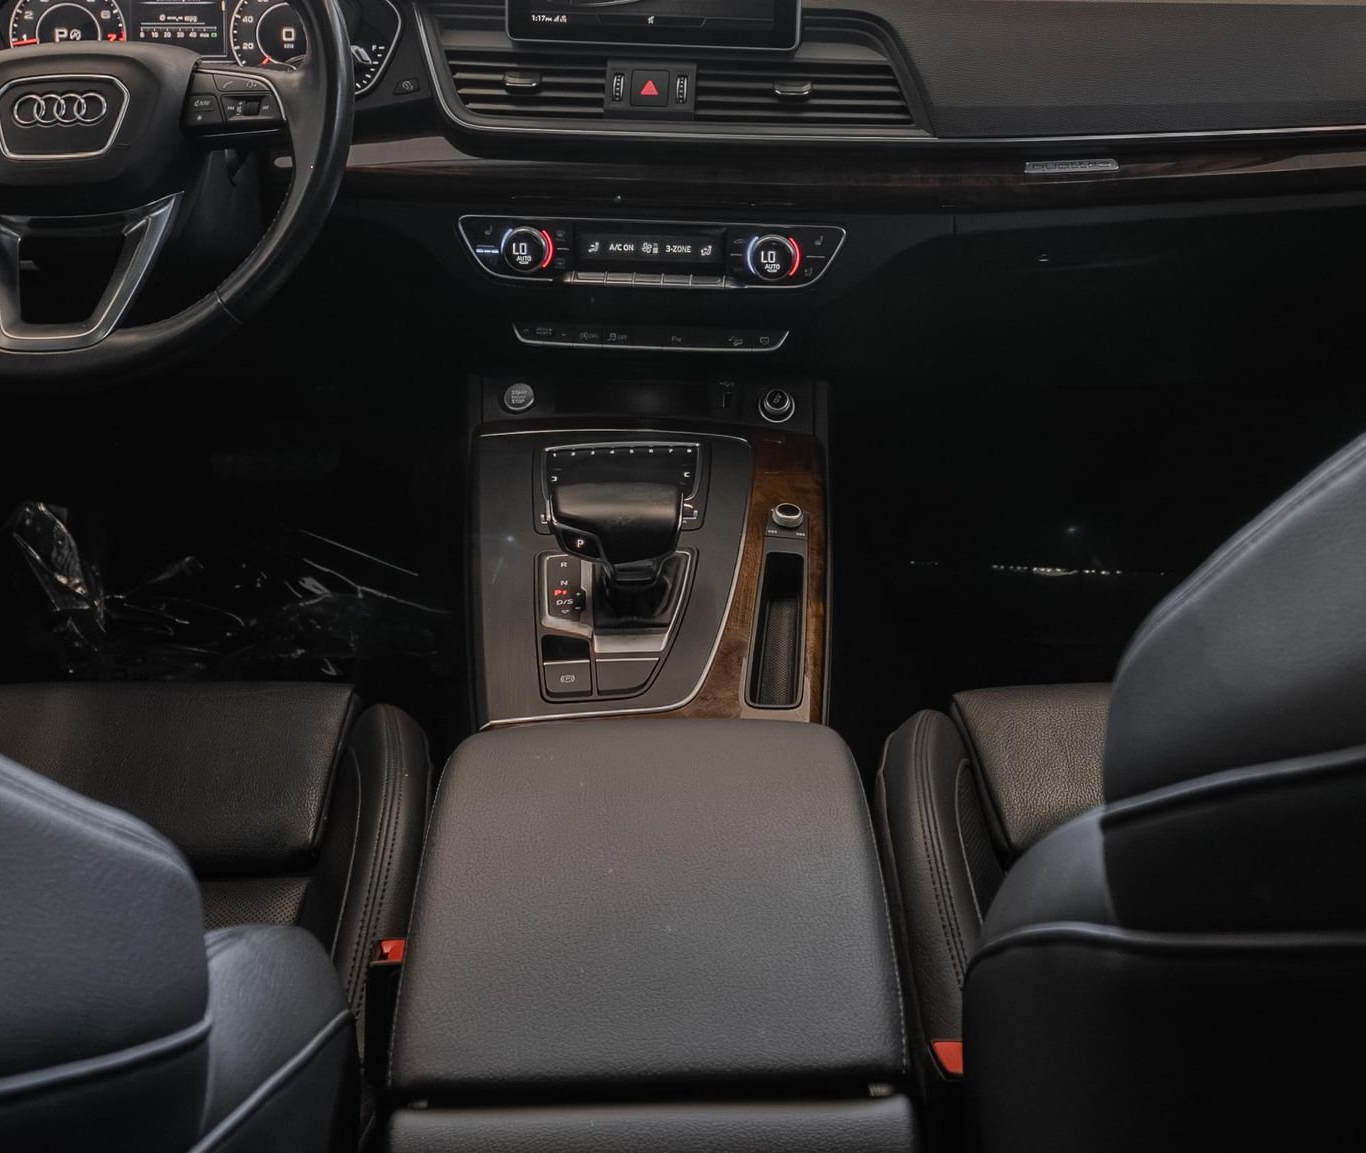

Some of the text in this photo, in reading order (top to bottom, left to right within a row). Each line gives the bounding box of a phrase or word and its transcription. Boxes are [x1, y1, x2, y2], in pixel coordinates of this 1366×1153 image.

[24, 10, 34, 20] 2
[100, 10, 111, 19] 6
[54, 28, 68, 42] P
[242, 42, 254, 50] 20
[512, 242, 527, 255] LO
[609, 243, 634, 253] A/C ON
[665, 244, 692, 254] 3-ZONE
[516, 254, 532, 262] AUTO
[760, 250, 776, 263] LO
[764, 262, 781, 270] AUTO
[577, 539, 584, 548] P
